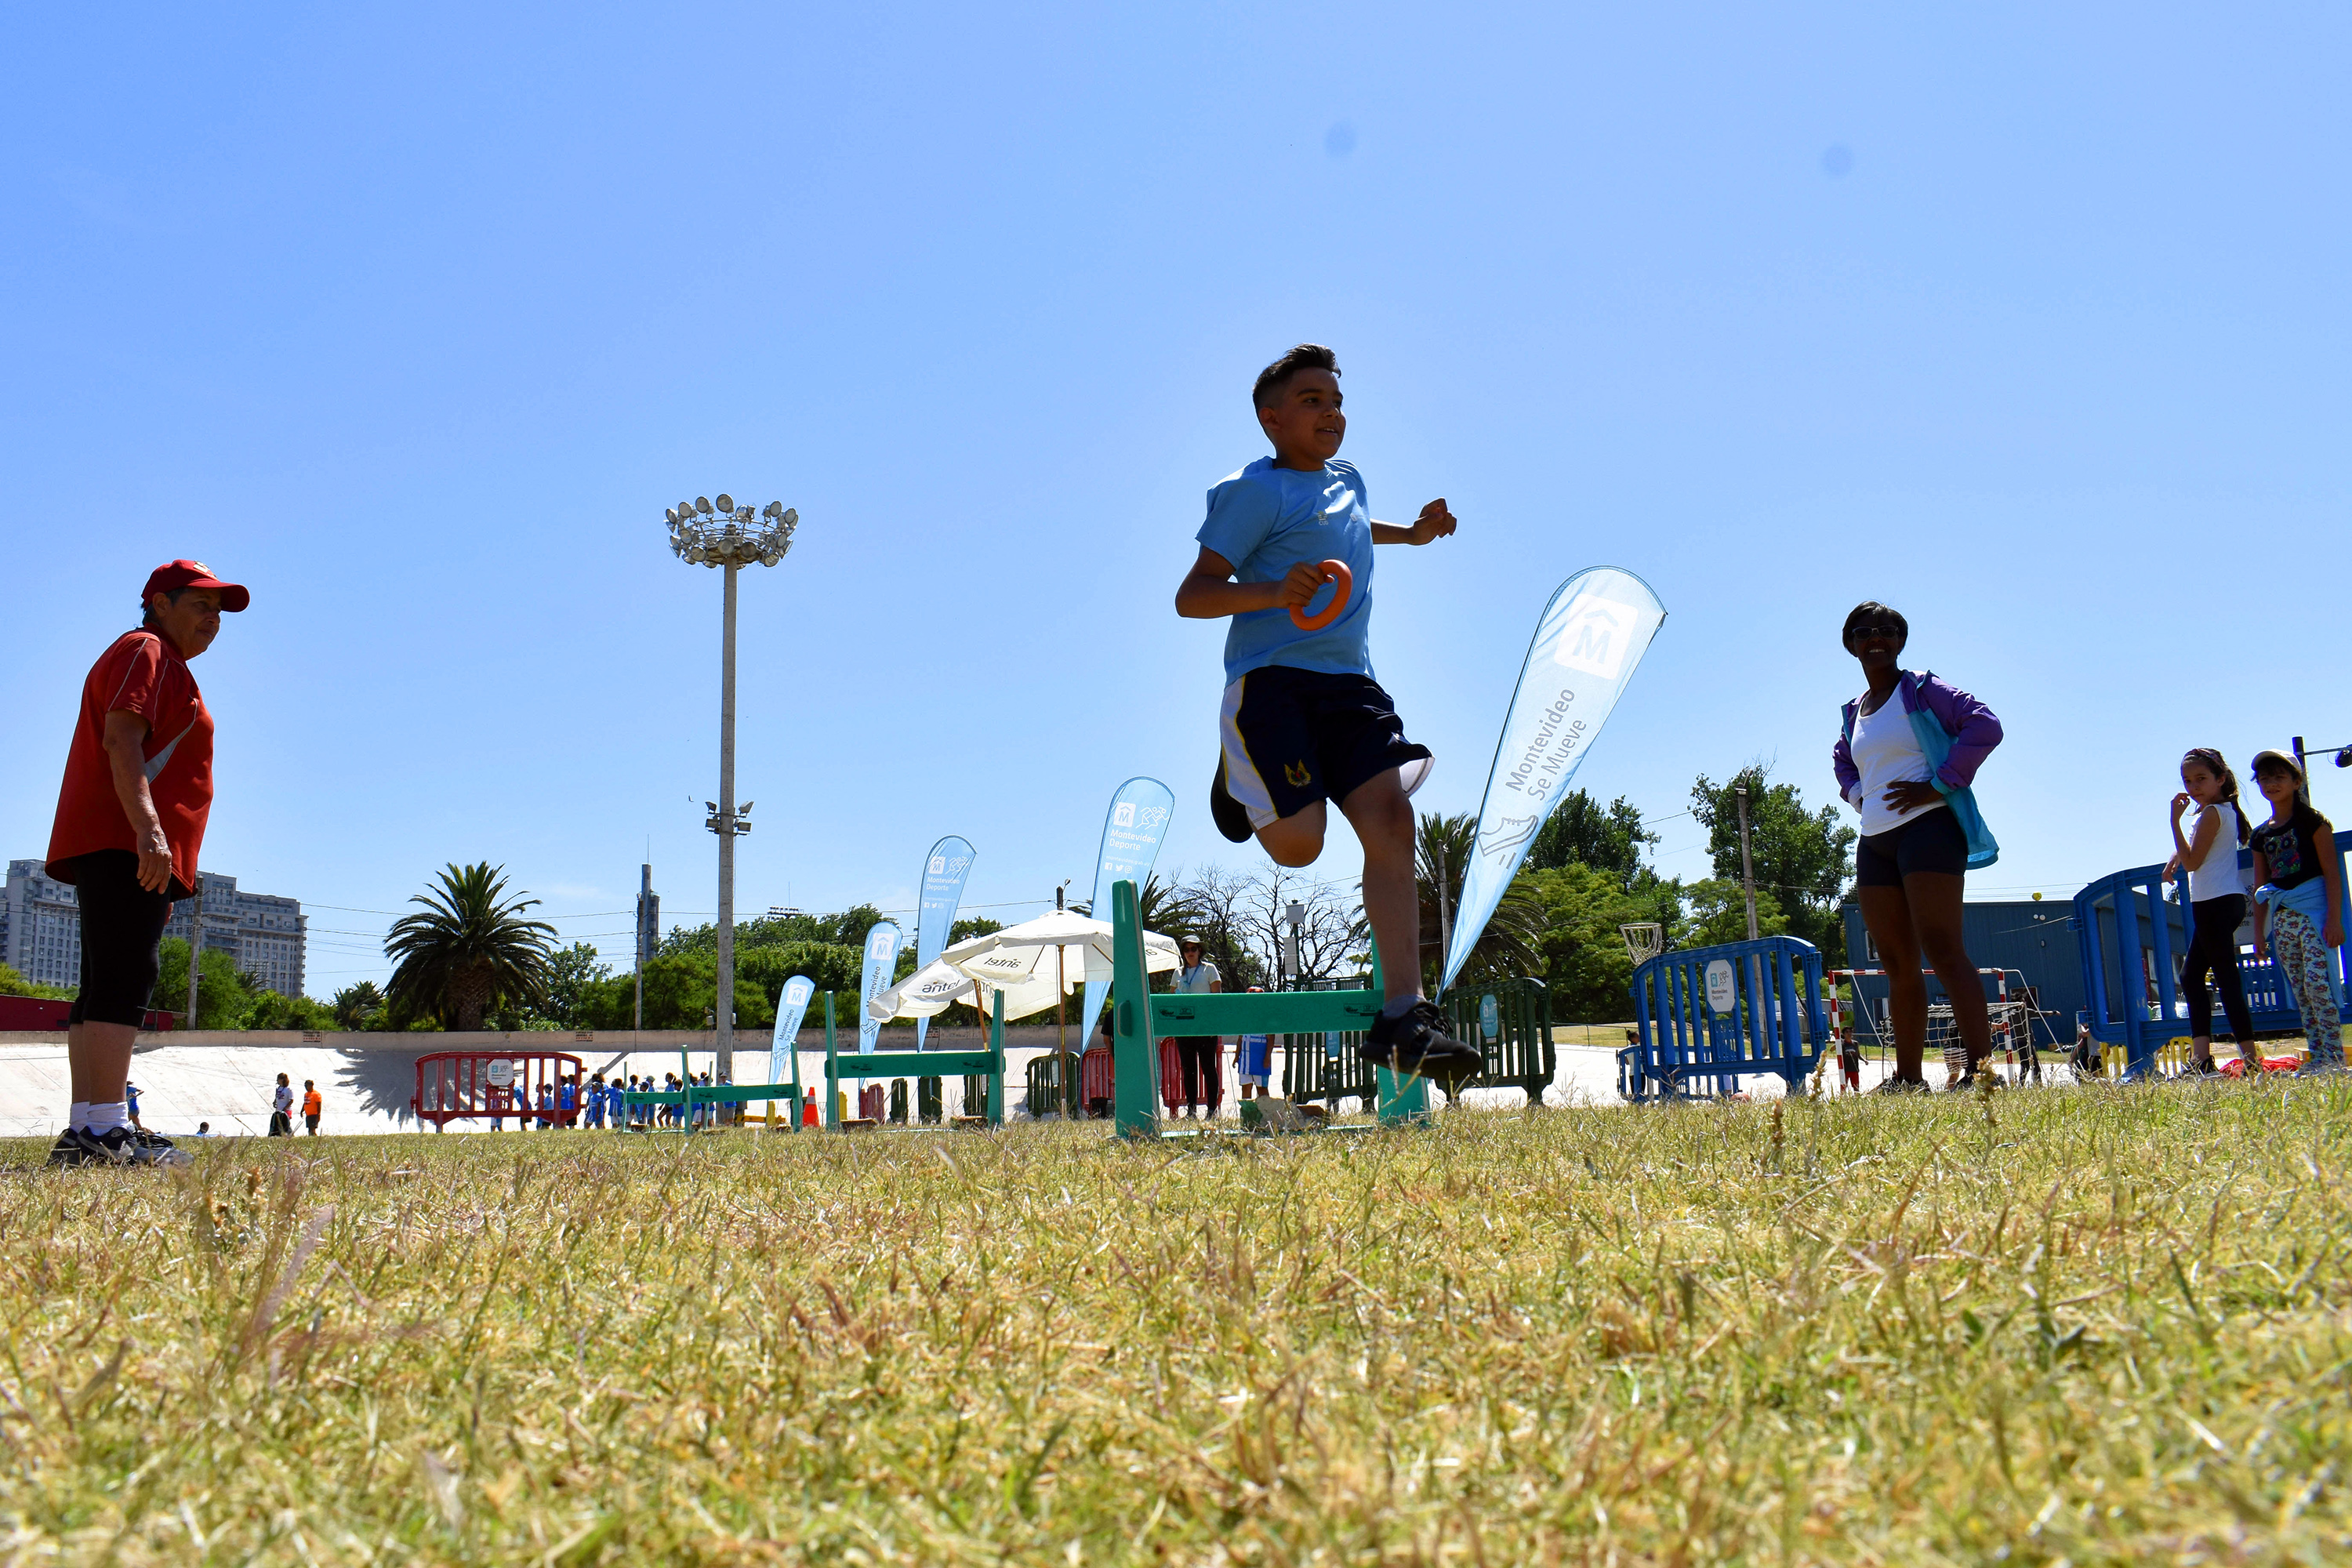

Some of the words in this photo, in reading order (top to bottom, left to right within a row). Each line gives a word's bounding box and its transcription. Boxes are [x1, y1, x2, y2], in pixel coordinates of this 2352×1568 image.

[1505, 689, 1575, 792] Montevideo
[1527, 778, 1552, 800] Se
[1541, 720, 1587, 775] Mueve
[1109, 838, 1141, 851] Deporte
[1110, 829, 1156, 844] Montevideo
[877, 975, 887, 996] ueve
[922, 979, 960, 993] antel
[779, 1009, 794, 1040] Montevideo
[788, 1017, 799, 1034] Mueve
